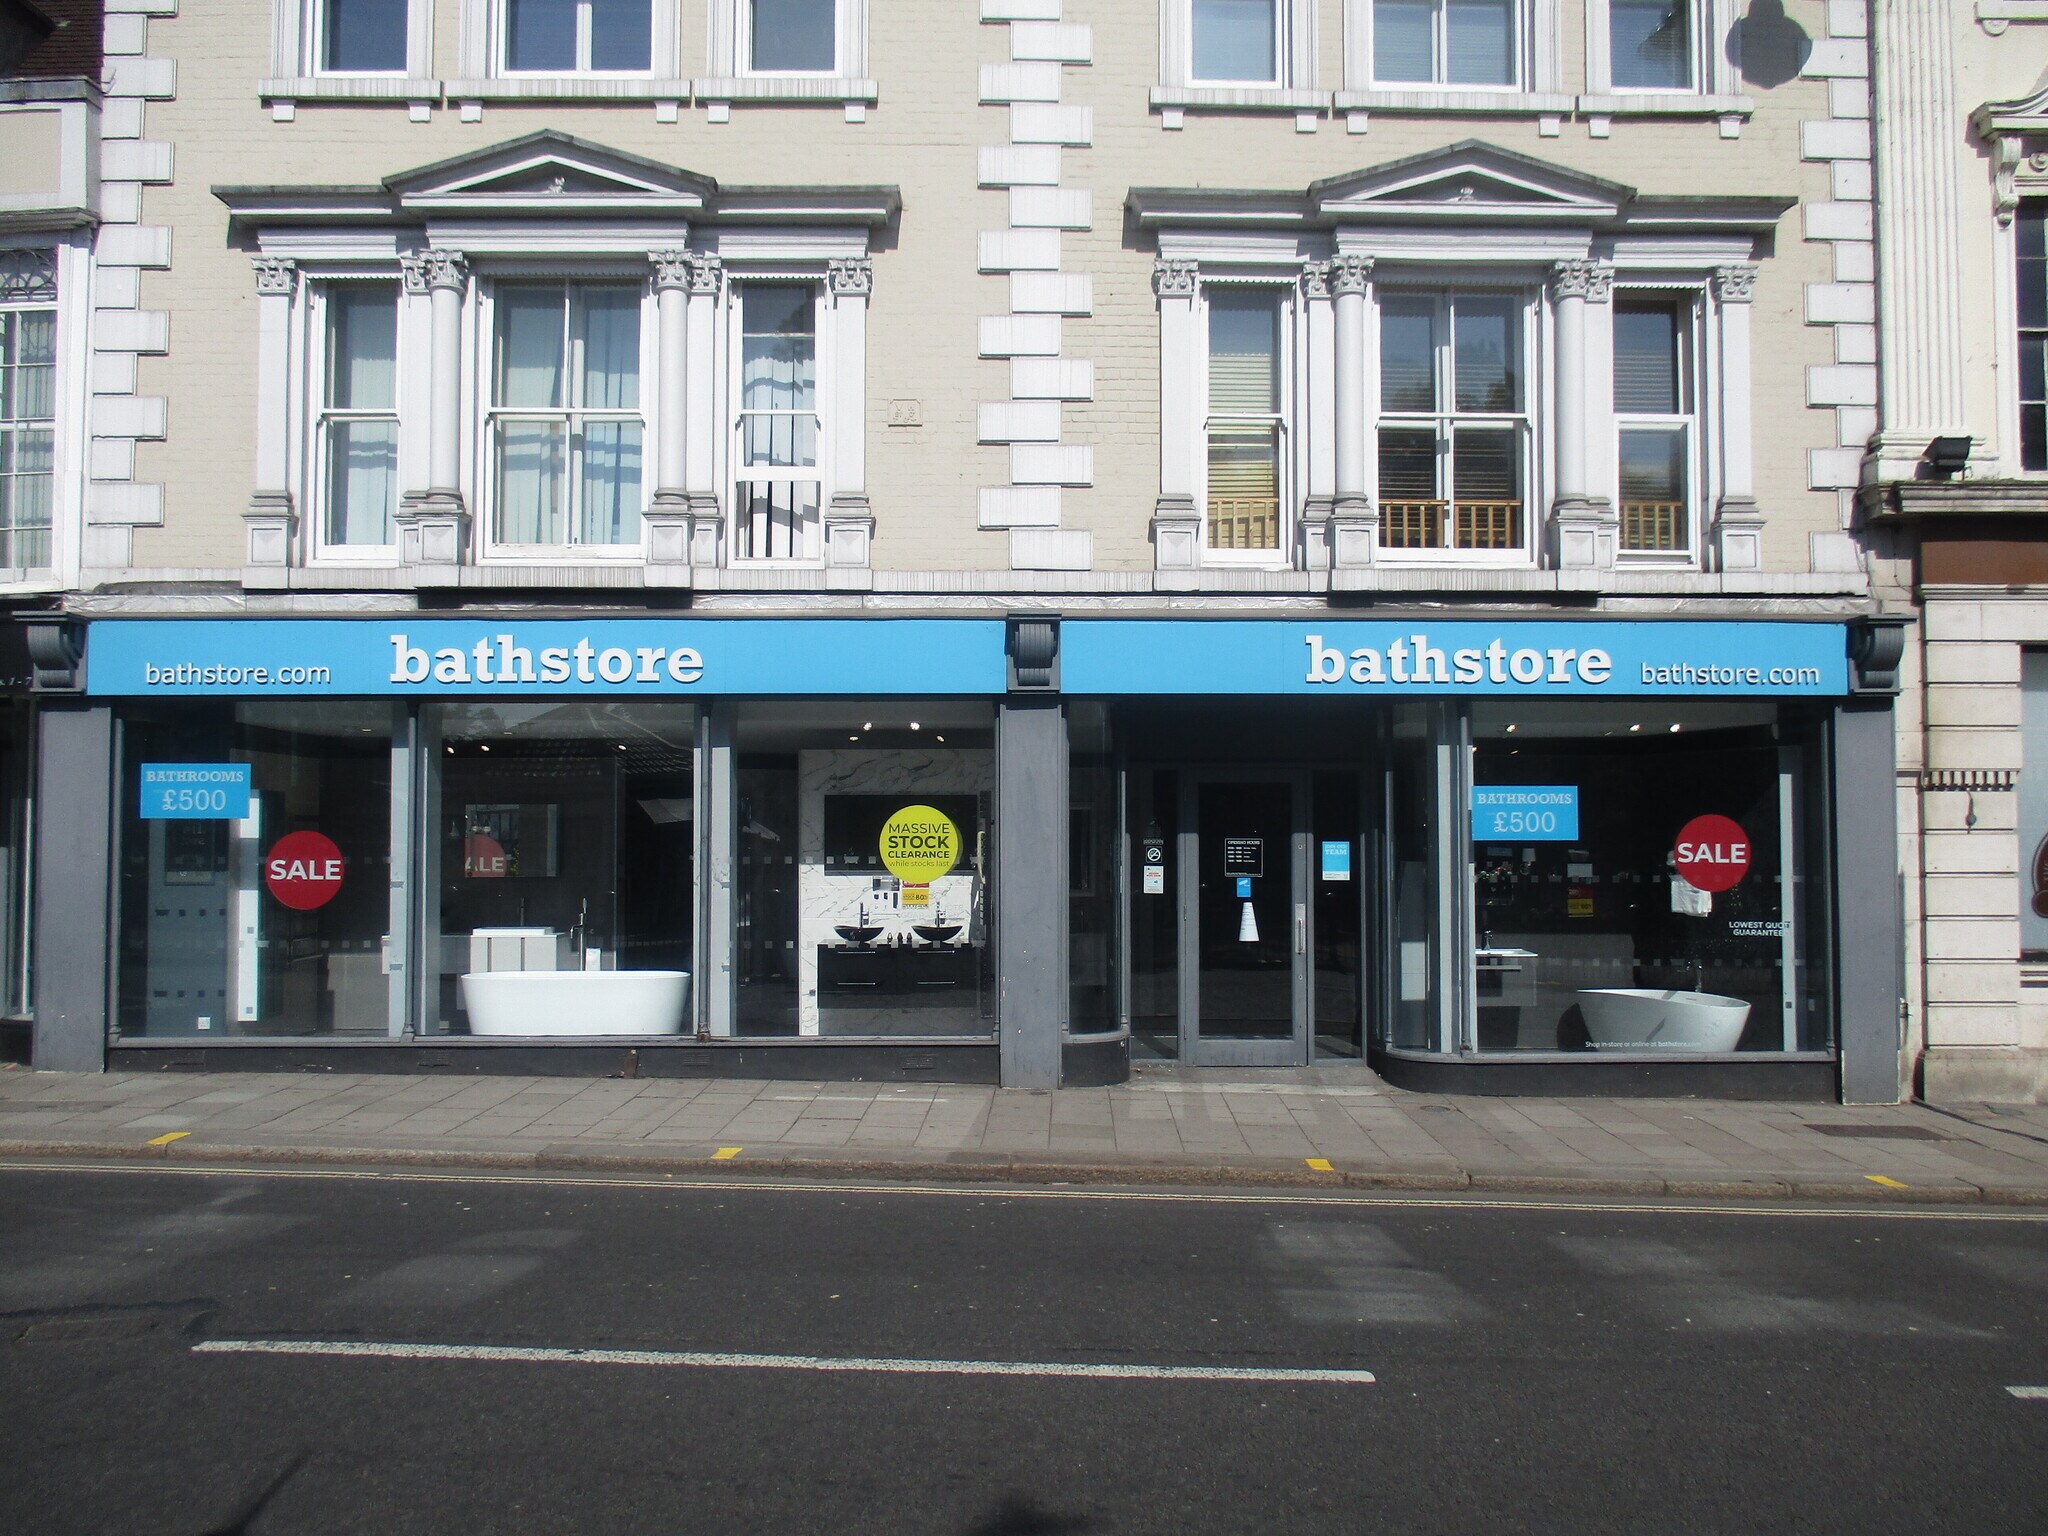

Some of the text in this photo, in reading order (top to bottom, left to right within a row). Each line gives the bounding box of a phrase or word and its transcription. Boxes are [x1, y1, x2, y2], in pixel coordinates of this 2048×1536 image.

[389, 634, 705, 684] bathstore
[1305, 635, 1613, 684] bathstore
[145, 662, 332, 685] bathstore.com
[1641, 662, 1821, 685] bathstore.com
[146, 770, 244, 782] BATHROOMS
[161, 789, 227, 811] £500
[1477, 793, 1573, 805] BATHROOMS
[888, 823, 950, 834] MASSIVE
[1493, 811, 1556, 833] £500
[888, 835, 950, 849] STOCK
[888, 850, 950, 859] CLEARANCE
[1677, 842, 1746, 864] SALE
[270, 859, 341, 880] SALE
[465, 857, 504, 872] ALE
[1728, 921, 1794, 929] LOWEST QUOT
[1732, 929, 1784, 937] GUARANTEE
[1585, 1041, 1600, 1049] Shop
